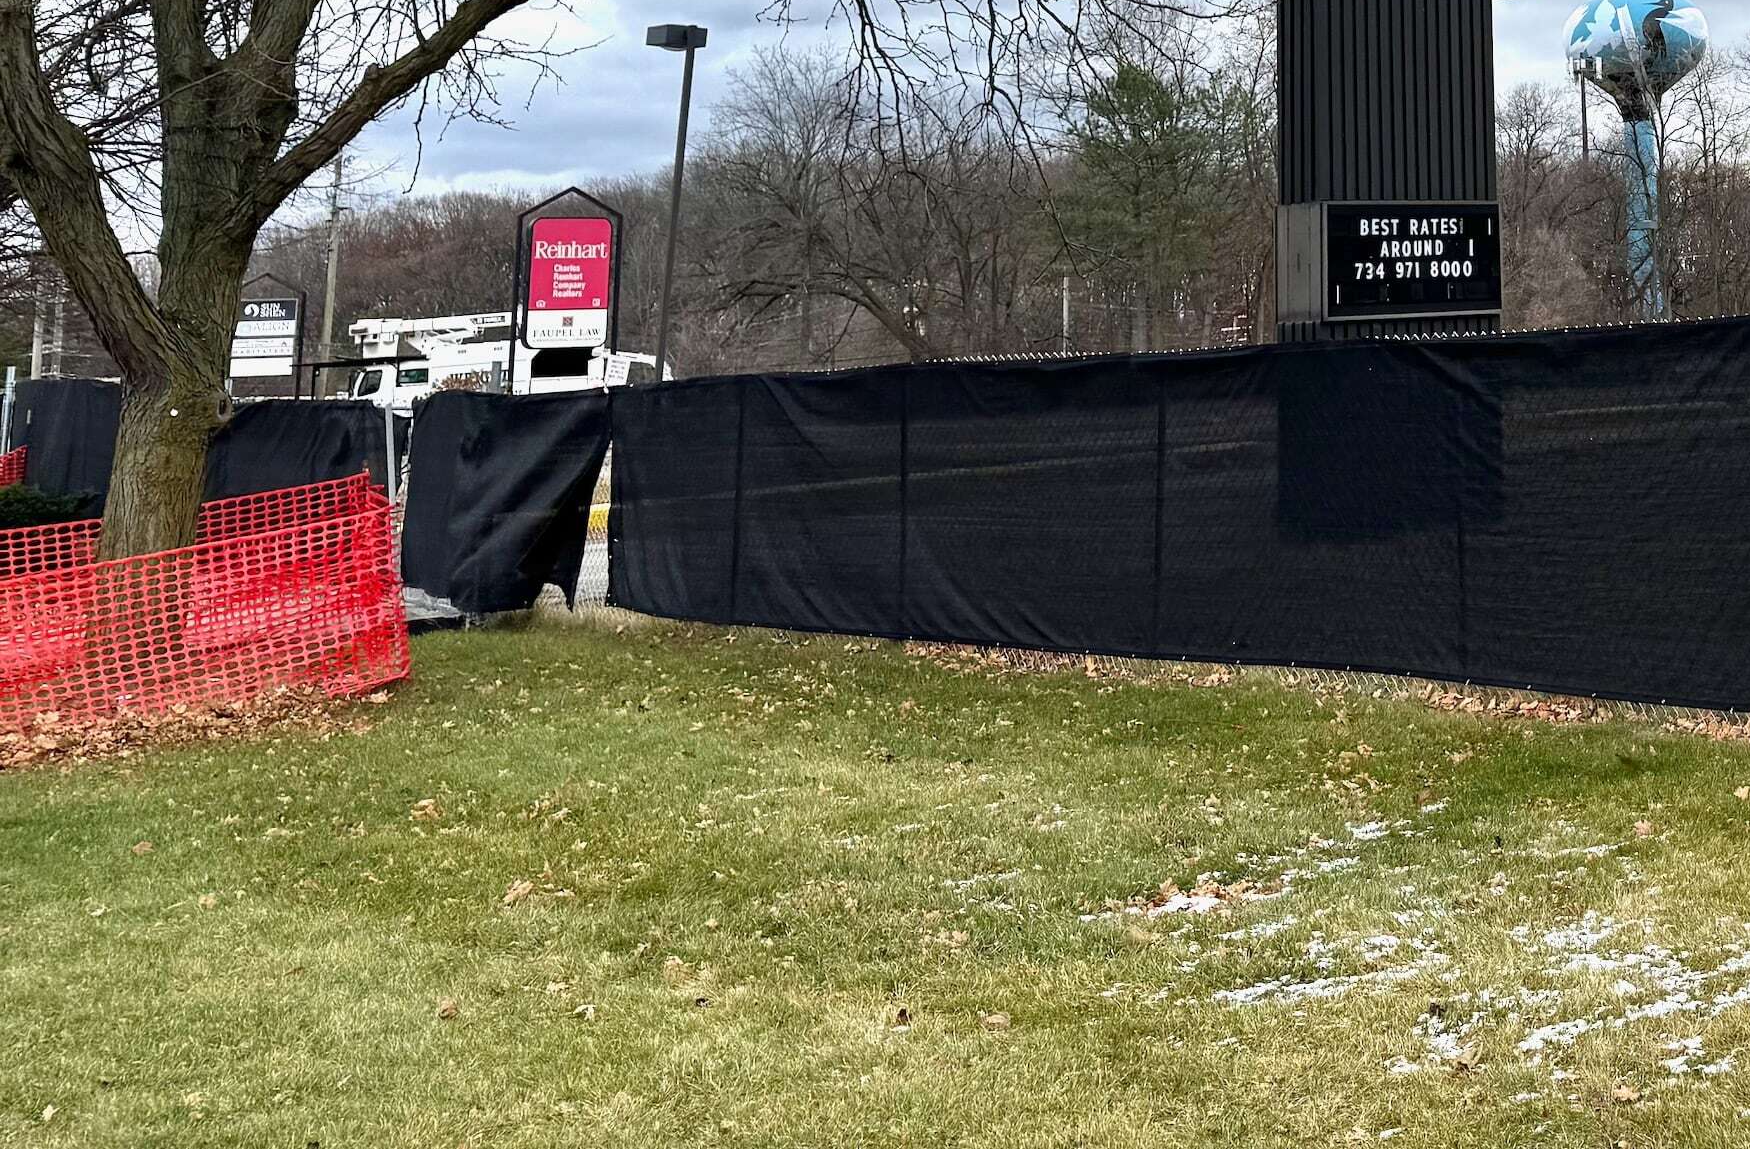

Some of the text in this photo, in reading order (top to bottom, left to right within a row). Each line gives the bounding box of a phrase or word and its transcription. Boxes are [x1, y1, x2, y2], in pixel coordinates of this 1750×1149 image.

[1360, 218, 1399, 236] BEST
[535, 240, 608, 259] Reinhart
[1380, 239, 1444, 258] AROUND
[553, 272, 583, 281] Reinhart
[1355, 260, 1473, 280] 734 971 8000
[552, 281, 586, 291] Company
[260, 302, 281, 310] SUN
[260, 309, 286, 318] SHEN
